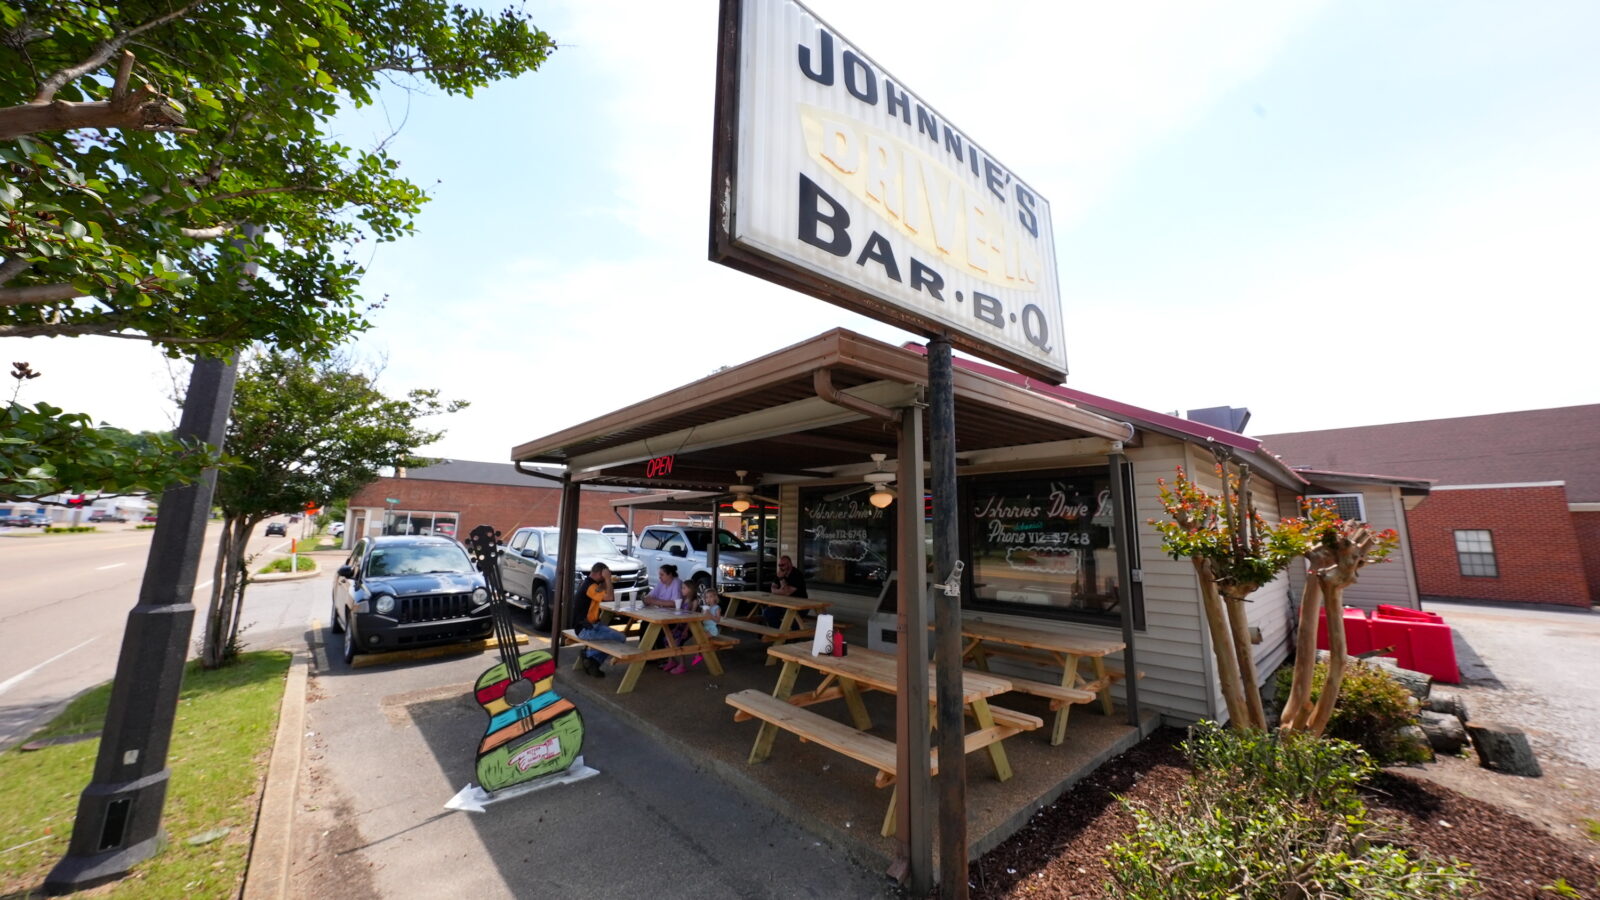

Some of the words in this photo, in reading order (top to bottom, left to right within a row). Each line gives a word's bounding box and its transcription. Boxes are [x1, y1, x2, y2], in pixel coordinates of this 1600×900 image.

[798, 28, 1038, 239] JOHNNIE'S
[646, 455, 674, 478] OPEN
[1047, 490, 1088, 518] Drive
[987, 519, 1025, 543] Phone
